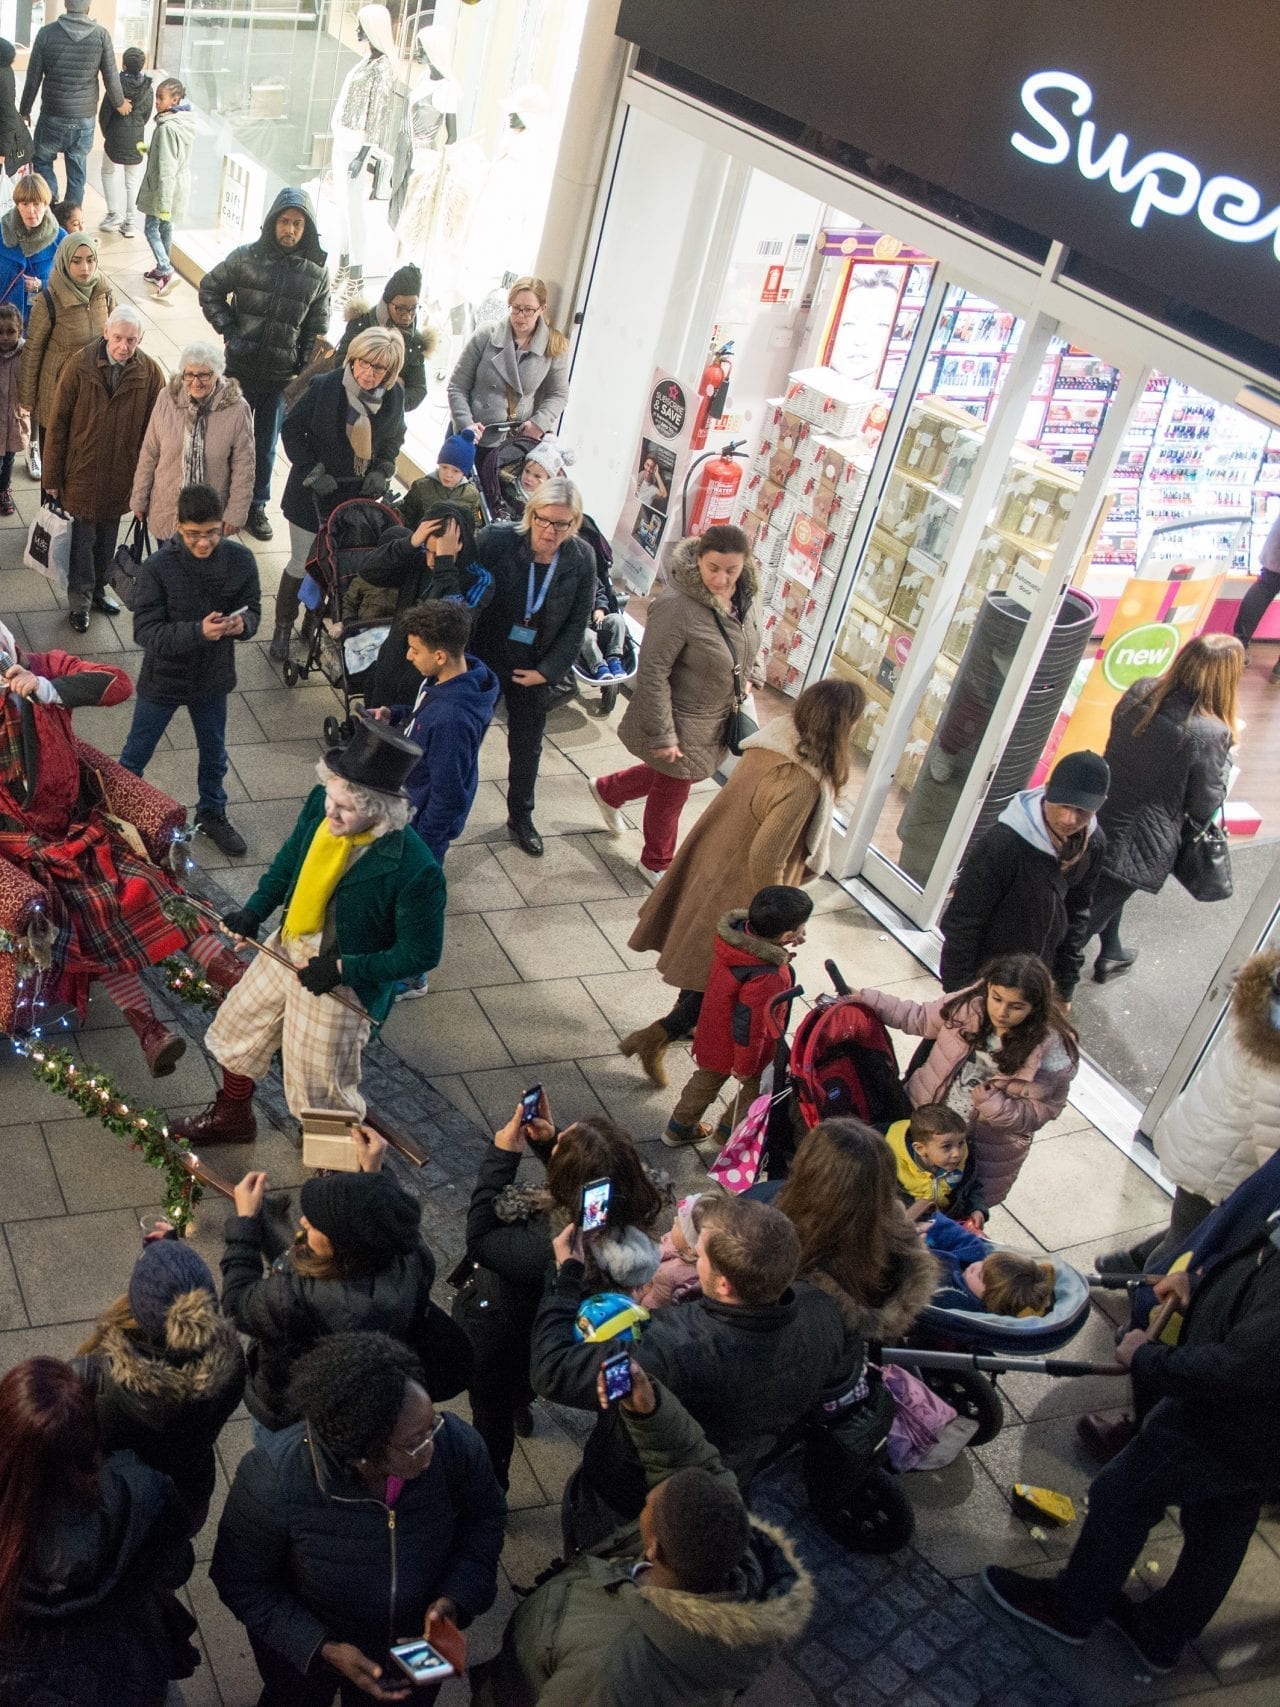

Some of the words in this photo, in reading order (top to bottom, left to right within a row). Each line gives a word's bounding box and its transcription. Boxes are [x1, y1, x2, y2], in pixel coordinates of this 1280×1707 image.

[1011, 71, 1280, 261] Supe
[225, 191, 240, 208] gift
[222, 206, 240, 225] card
[660, 403, 682, 426] SAVE
[1115, 647, 1170, 665] new
